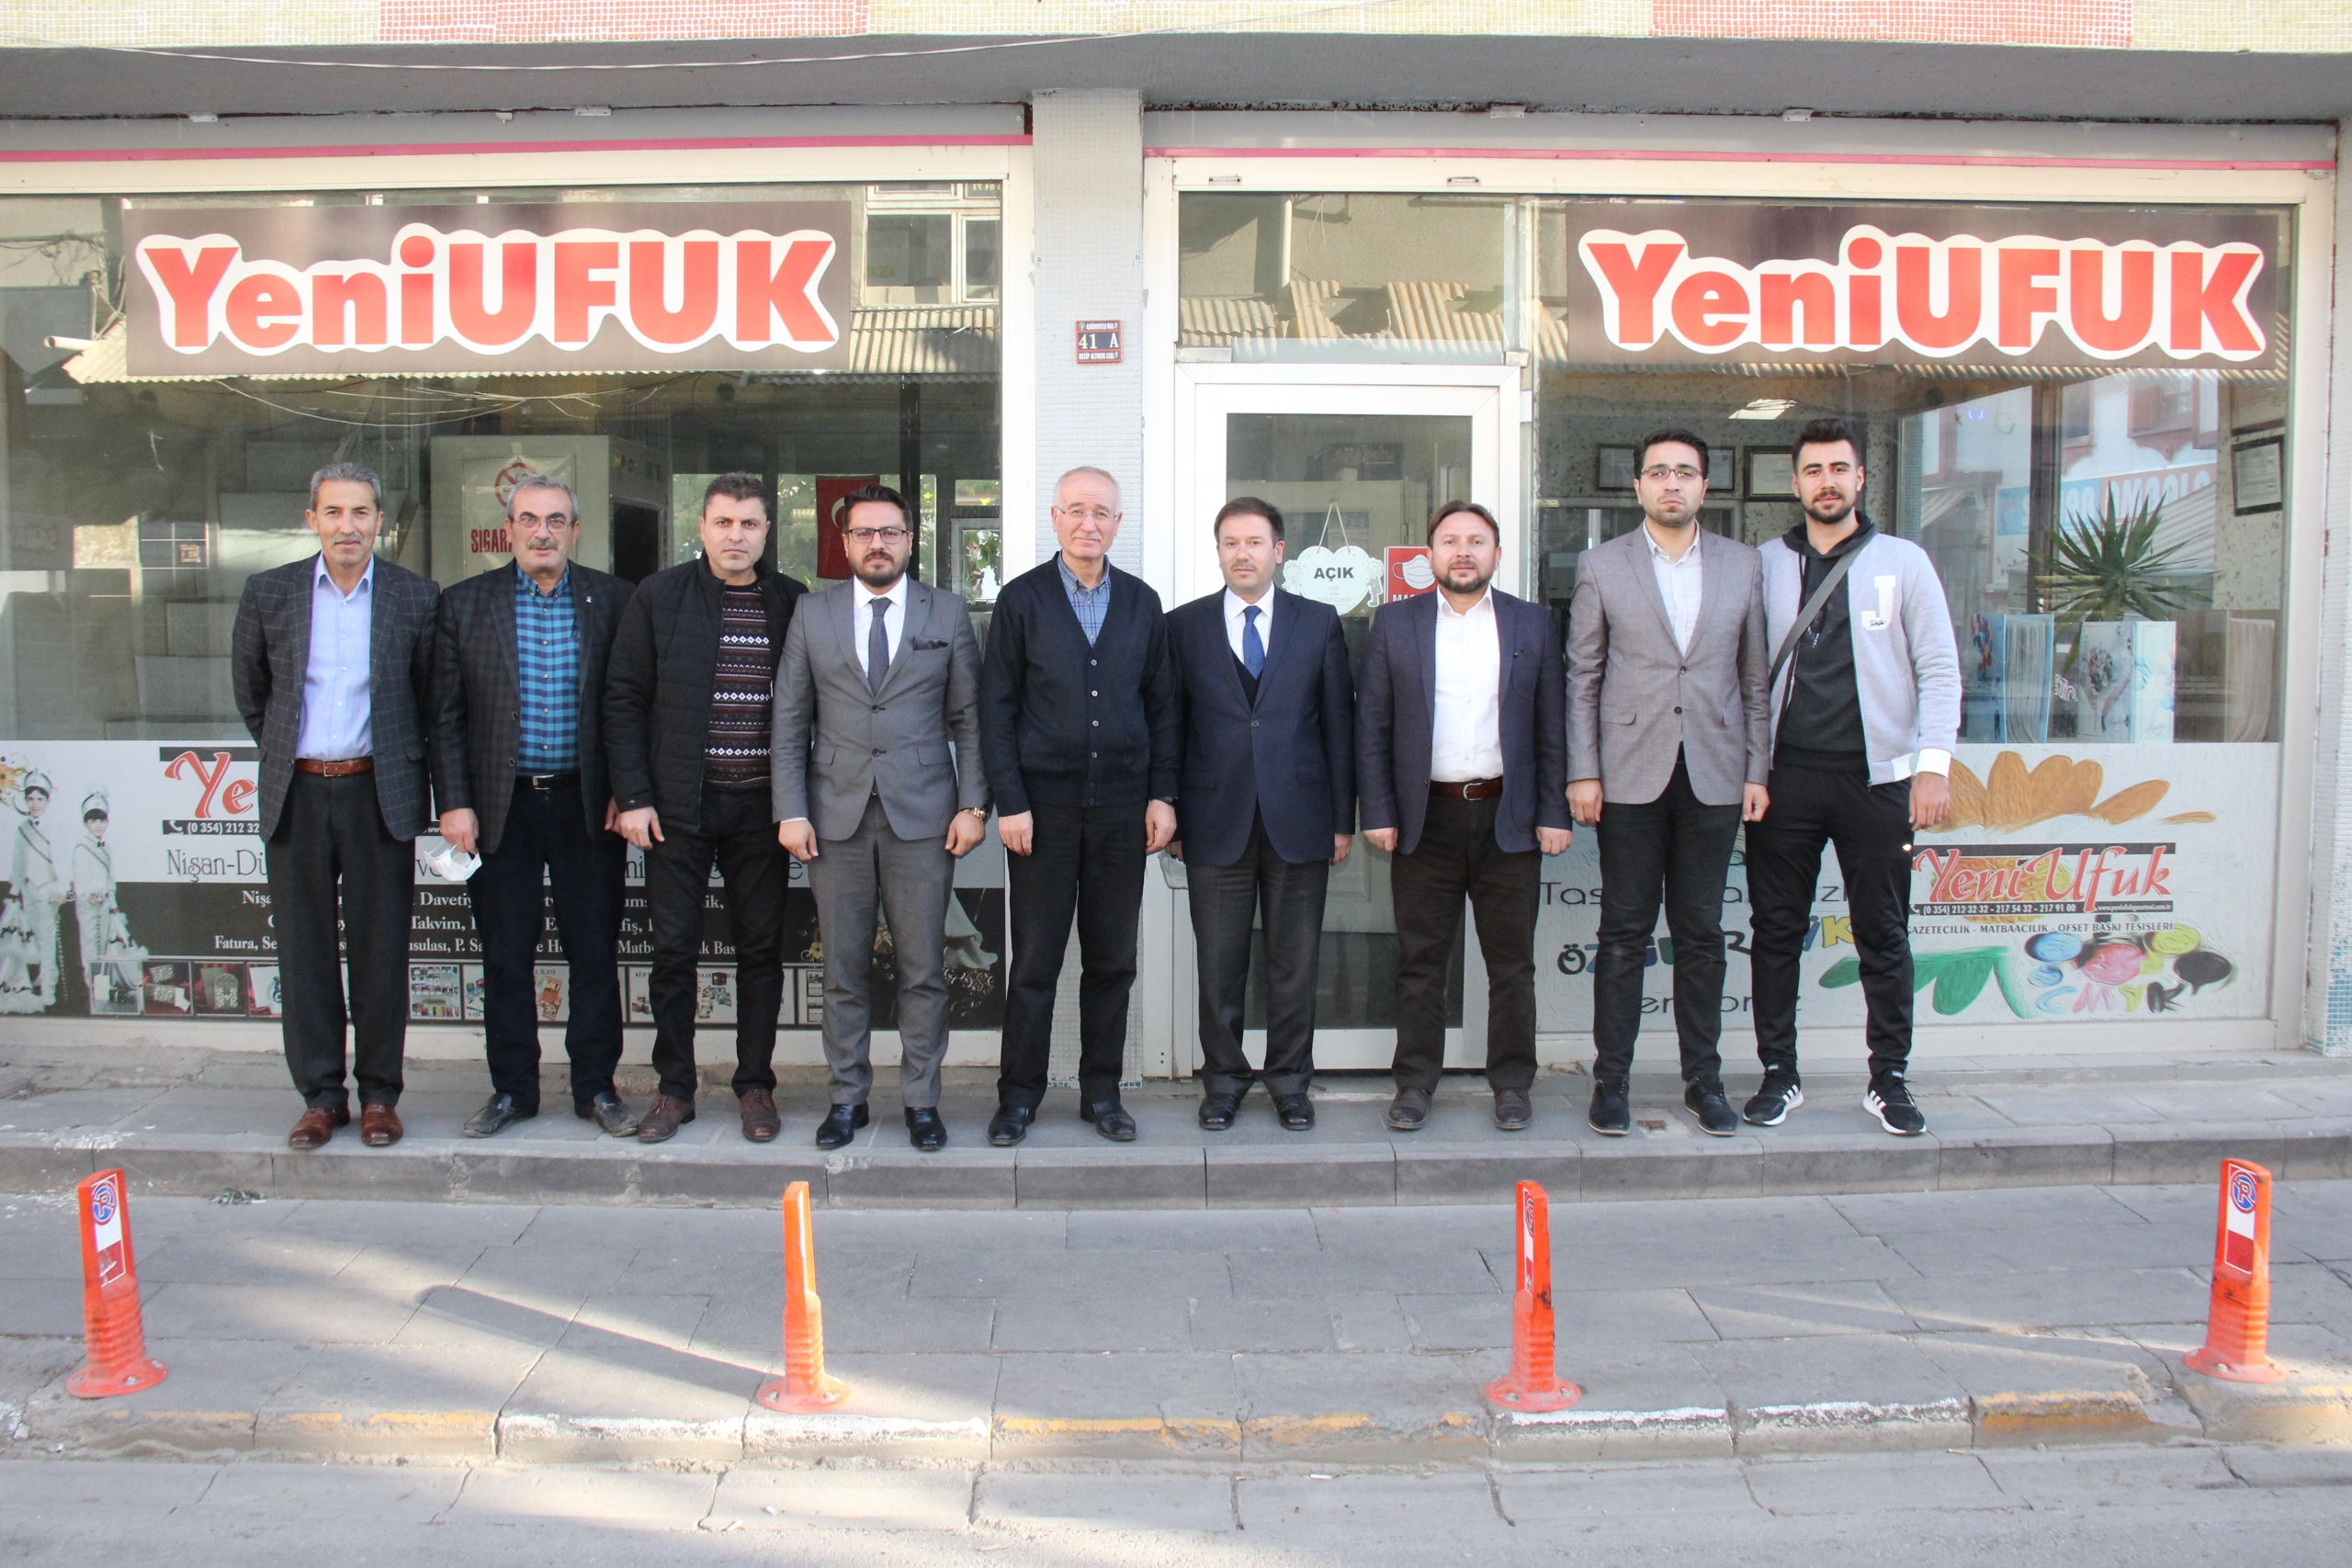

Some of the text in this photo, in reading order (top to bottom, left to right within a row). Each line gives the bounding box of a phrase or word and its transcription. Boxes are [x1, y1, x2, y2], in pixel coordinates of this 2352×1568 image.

[142, 234, 838, 347] YeniUFUK
[1585, 236, 2266, 355] YeniUFUK
[1079, 333, 1119, 349] 41 A
[1314, 567, 1354, 581] AÇIK
[200, 822, 223, 835] 354)
[226, 822, 244, 833] 212
[247, 822, 260, 833] 32
[1912, 845, 2173, 913] Yeni Ufuk
[1933, 905, 1950, 915] 354)
[1951, 905, 1965, 913] 212
[1967, 905, 1977, 913] 32
[1978, 905, 1988, 913] 32
[1996, 904, 2010, 913] 217
[2011, 904, 2020, 913] 54
[2022, 904, 2032, 913] 32
[2040, 904, 2053, 912] 217
[2054, 904, 2064, 912] 91
[2065, 904, 2076, 912] 00
[1980, 923, 2048, 933] MATBAACILIK
[2058, 922, 2089, 932] OFSET
[2093, 922, 2121, 931] BASKI
[2125, 920, 2173, 931] TESİSLERİ
[214, 935, 258, 951] Fatura,
